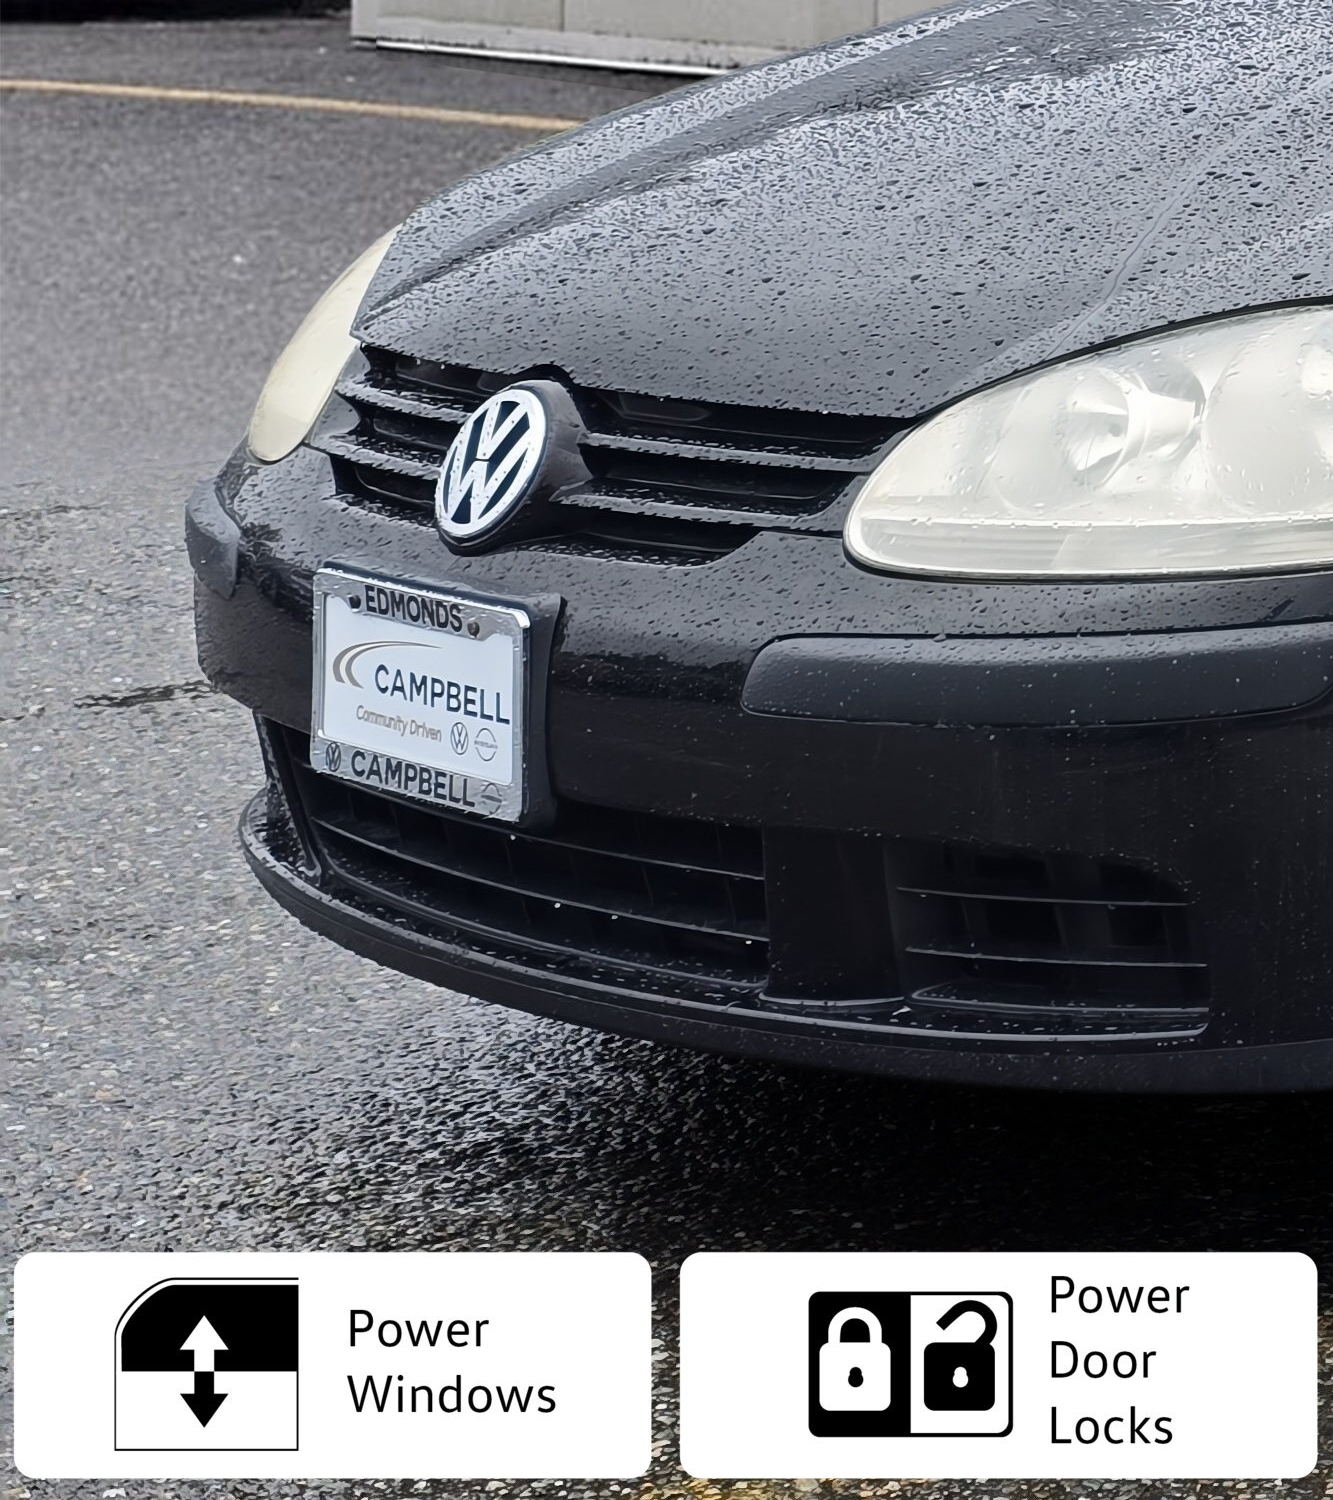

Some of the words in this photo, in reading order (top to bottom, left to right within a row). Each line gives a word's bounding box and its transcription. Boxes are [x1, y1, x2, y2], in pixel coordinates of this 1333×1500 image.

[364, 584, 463, 632] EDMONDS
[374, 664, 510, 725] CAMPBELL
[356, 705, 408, 737] Community
[410, 720, 442, 743] Driven
[351, 750, 476, 808] CAMPBELL
